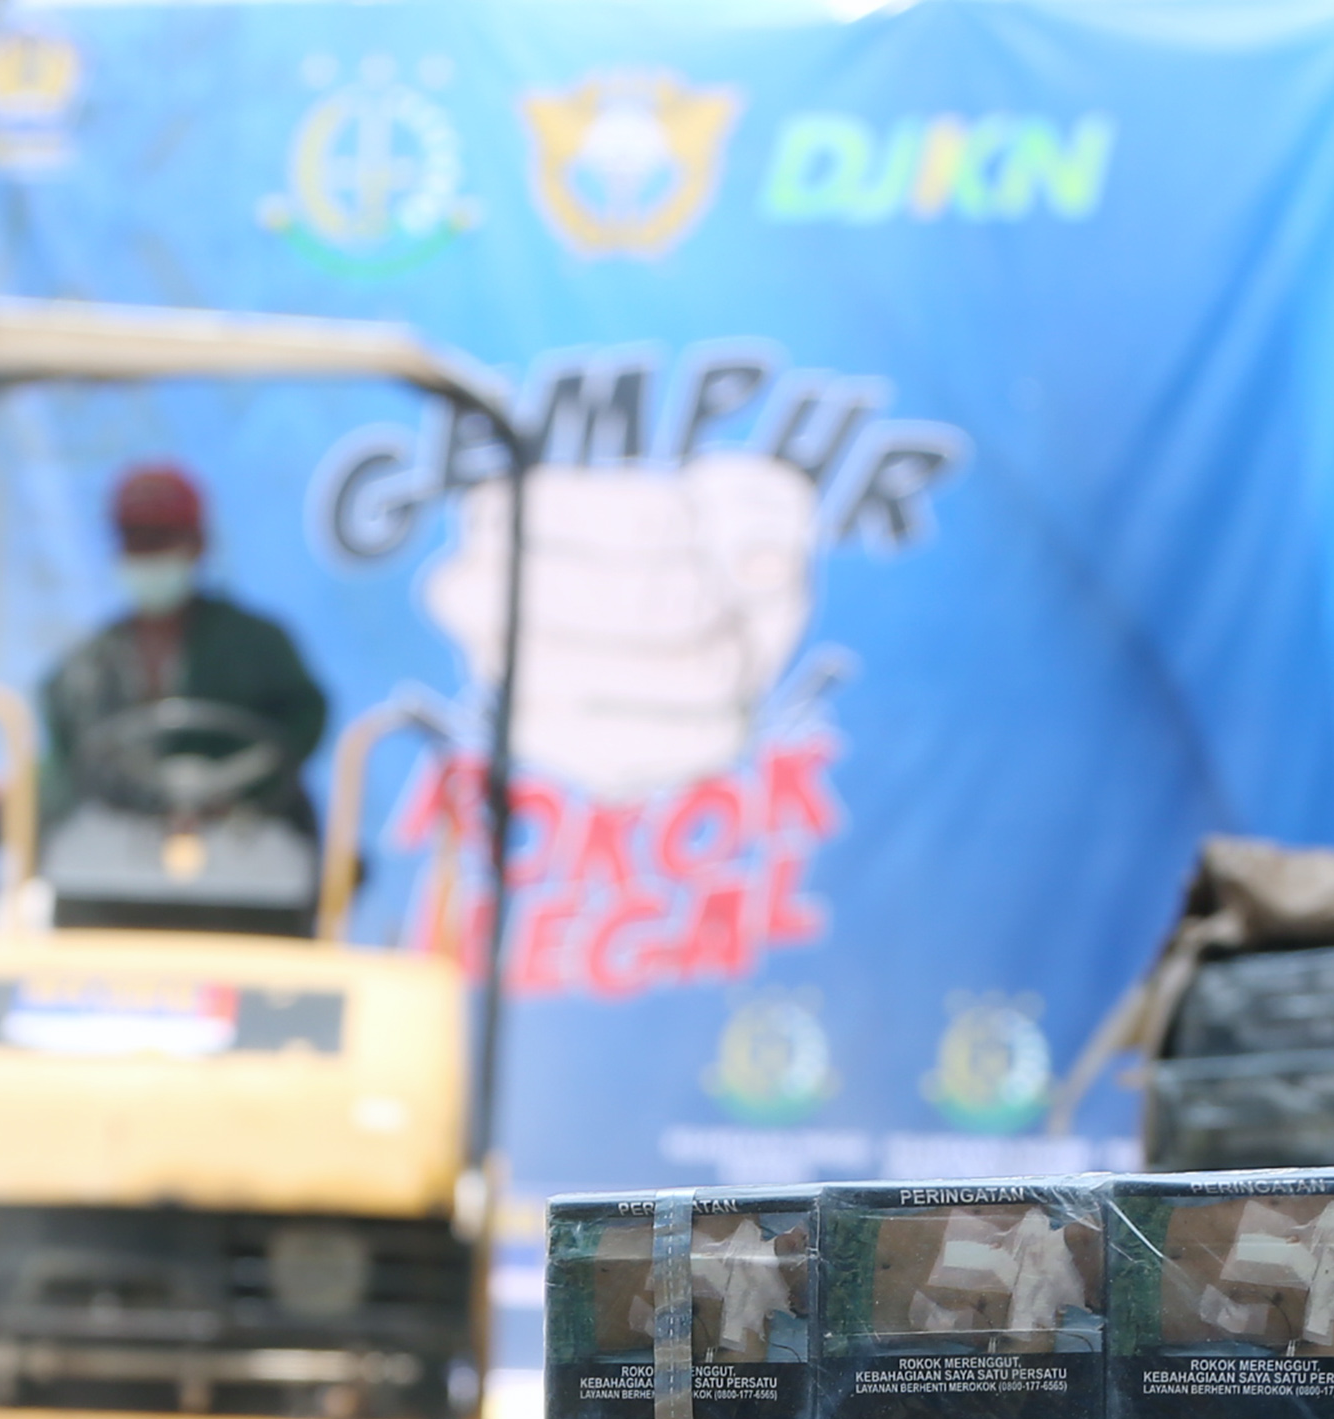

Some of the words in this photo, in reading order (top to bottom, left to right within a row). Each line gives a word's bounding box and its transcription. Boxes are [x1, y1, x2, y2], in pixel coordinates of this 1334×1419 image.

[900, 1188, 1024, 1205] PERINGATAN
[899, 1357, 940, 1370] ROKOK
[1191, 1359, 1235, 1371] ROKOK
[856, 1370, 941, 1383] KEBAHAGIAAN
[944, 1370, 974, 1381] SAYA
[978, 1370, 1008, 1380] SATU
[1012, 1369, 1067, 1379] PERSATU
[1144, 1371, 1236, 1383] KEBAHAGIAAN
[1240, 1372, 1271, 1383] SAYA
[1274, 1372, 1306, 1383] SATU
[695, 1378, 723, 1388] SATU
[726, 1378, 777, 1388] PERSATU
[856, 1384, 898, 1393] LAYANAN
[900, 1383, 946, 1392] BERHENTI
[949, 1382, 996, 1392] MEROKOK
[580, 1390, 619, 1399] LAYANAN
[1143, 1385, 1189, 1394] LAYANAN
[1191, 1385, 1240, 1394] BERHENTI
[1243, 1385, 1293, 1395] MEROKOK
